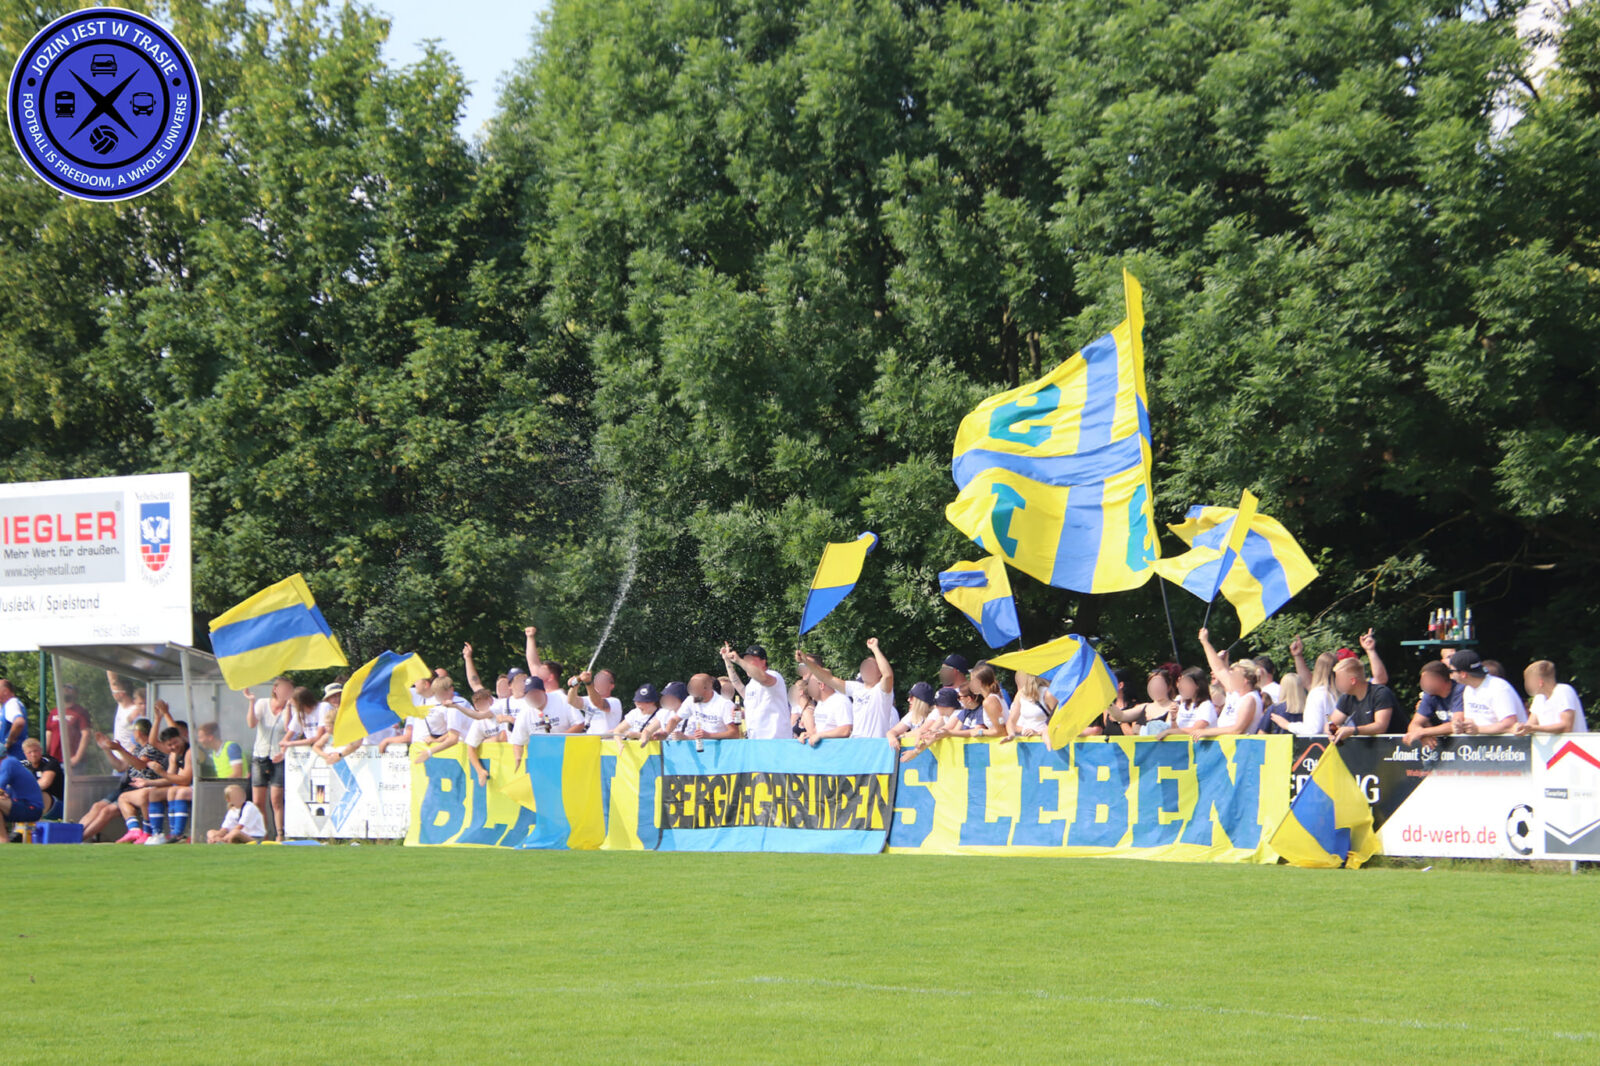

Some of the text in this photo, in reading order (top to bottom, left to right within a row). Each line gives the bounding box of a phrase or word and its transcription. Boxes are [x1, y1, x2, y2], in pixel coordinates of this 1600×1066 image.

[0, 511, 116, 545] IEGLER
[4, 544, 120, 559] Mehr Wert für draußen.
[4, 562, 86, 580] www.ziegler-metall.com
[47, 593, 100, 614] Spielstand
[1421, 745, 1438, 761] Sie
[1441, 751, 1455, 761] am
[886, 739, 1267, 849] SLEBEN
[1402, 824, 1497, 844] dd-werb.de
